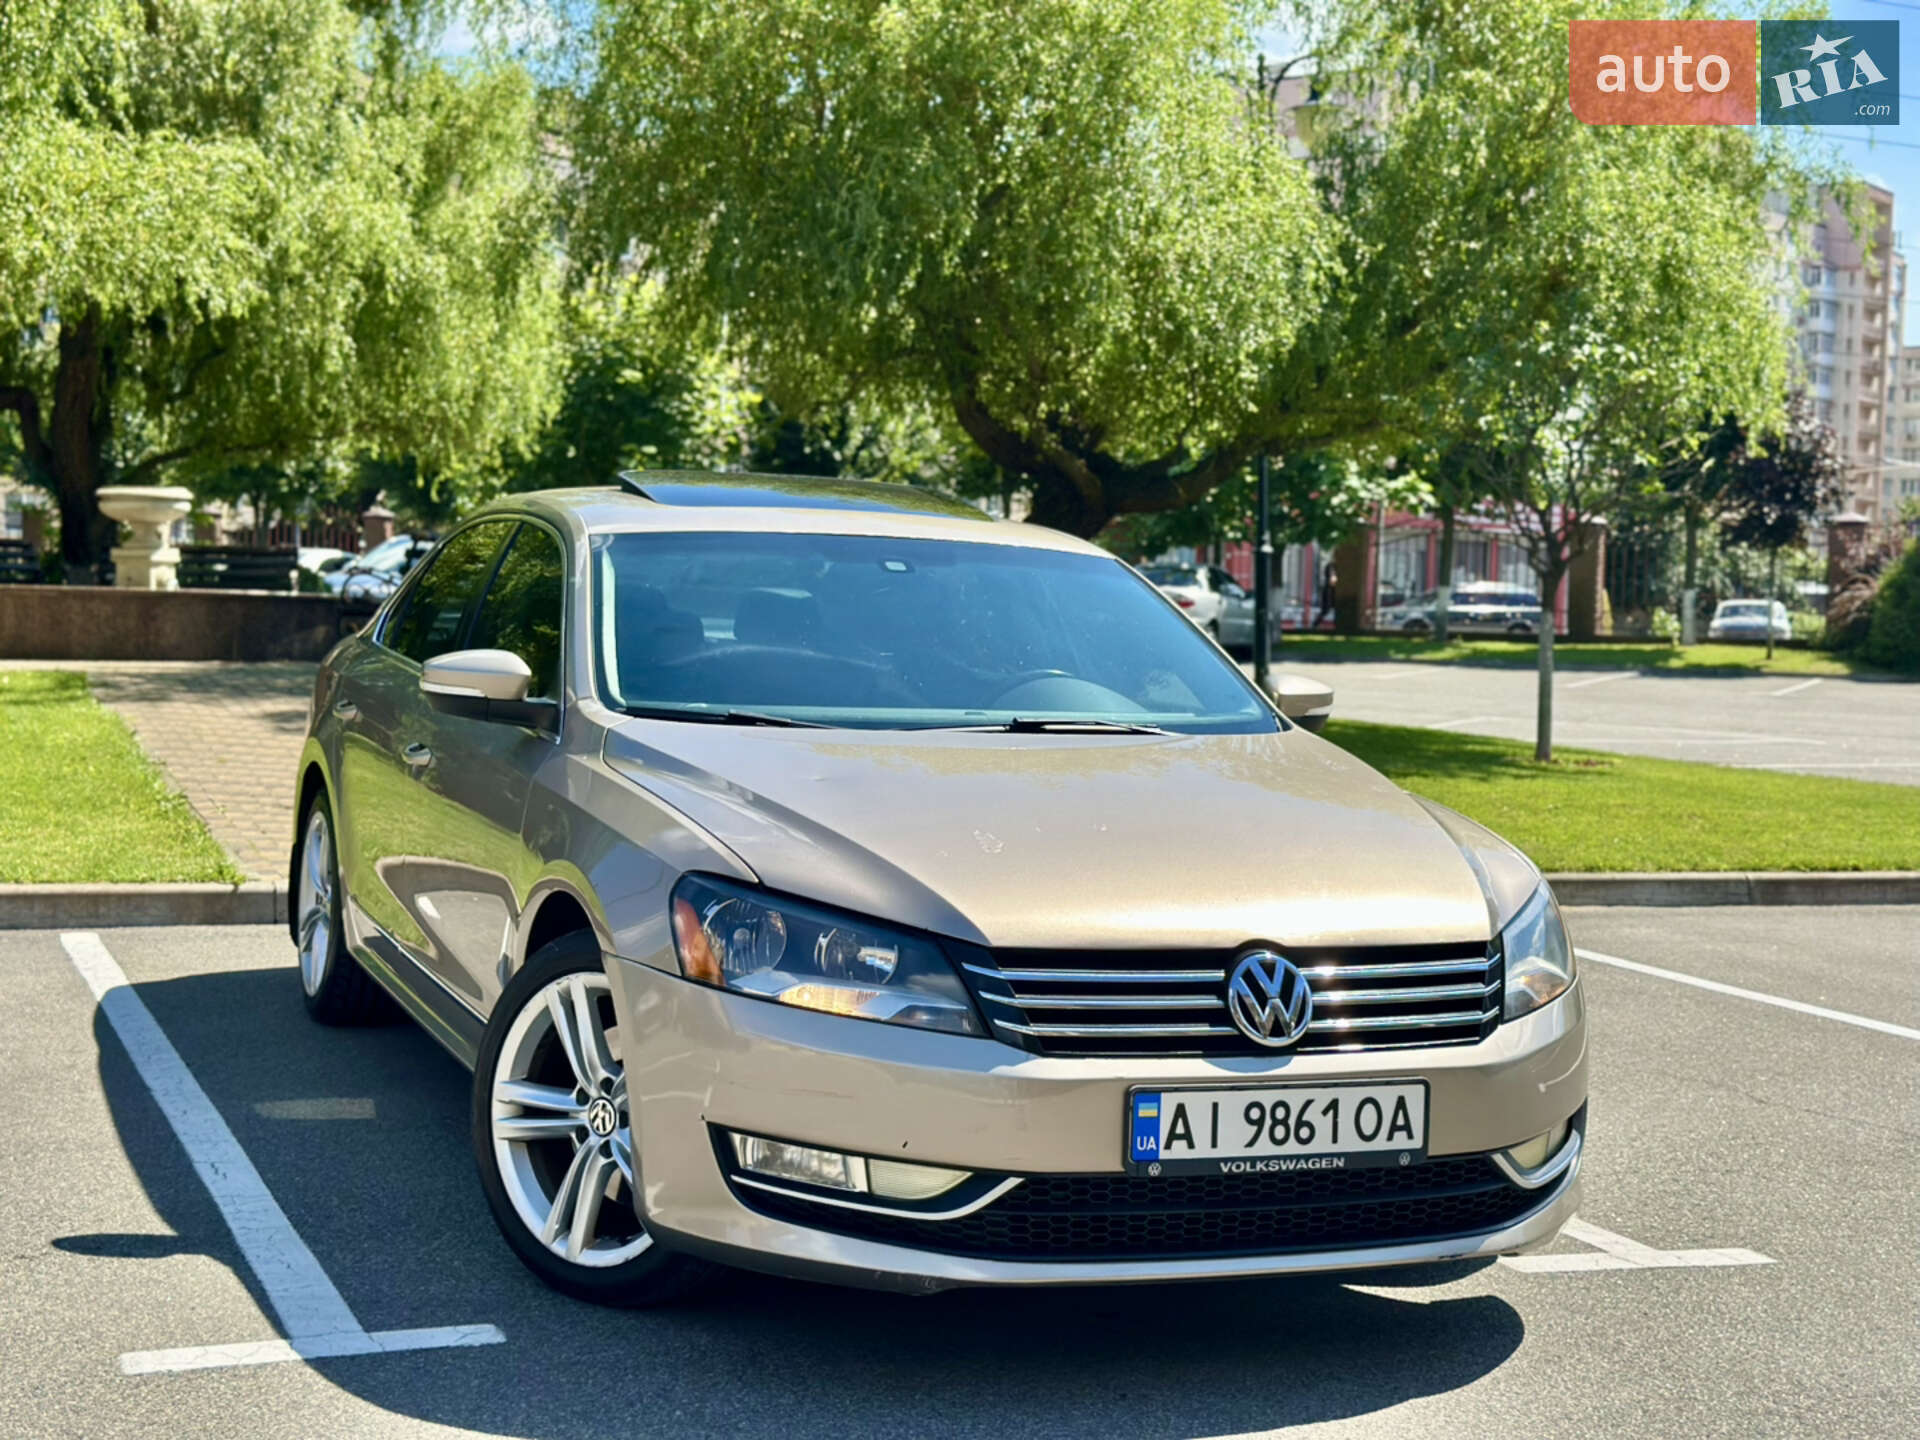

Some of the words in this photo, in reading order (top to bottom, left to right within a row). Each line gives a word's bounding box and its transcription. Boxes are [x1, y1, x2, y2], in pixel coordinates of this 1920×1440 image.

[1163, 1101, 1219, 1150] AI
[1243, 1098, 1340, 1148] 9861
[1354, 1095, 1414, 1142] OA
[1137, 1136, 1158, 1151] UA
[1219, 1157, 1345, 1173] VOLKSWAGEN
